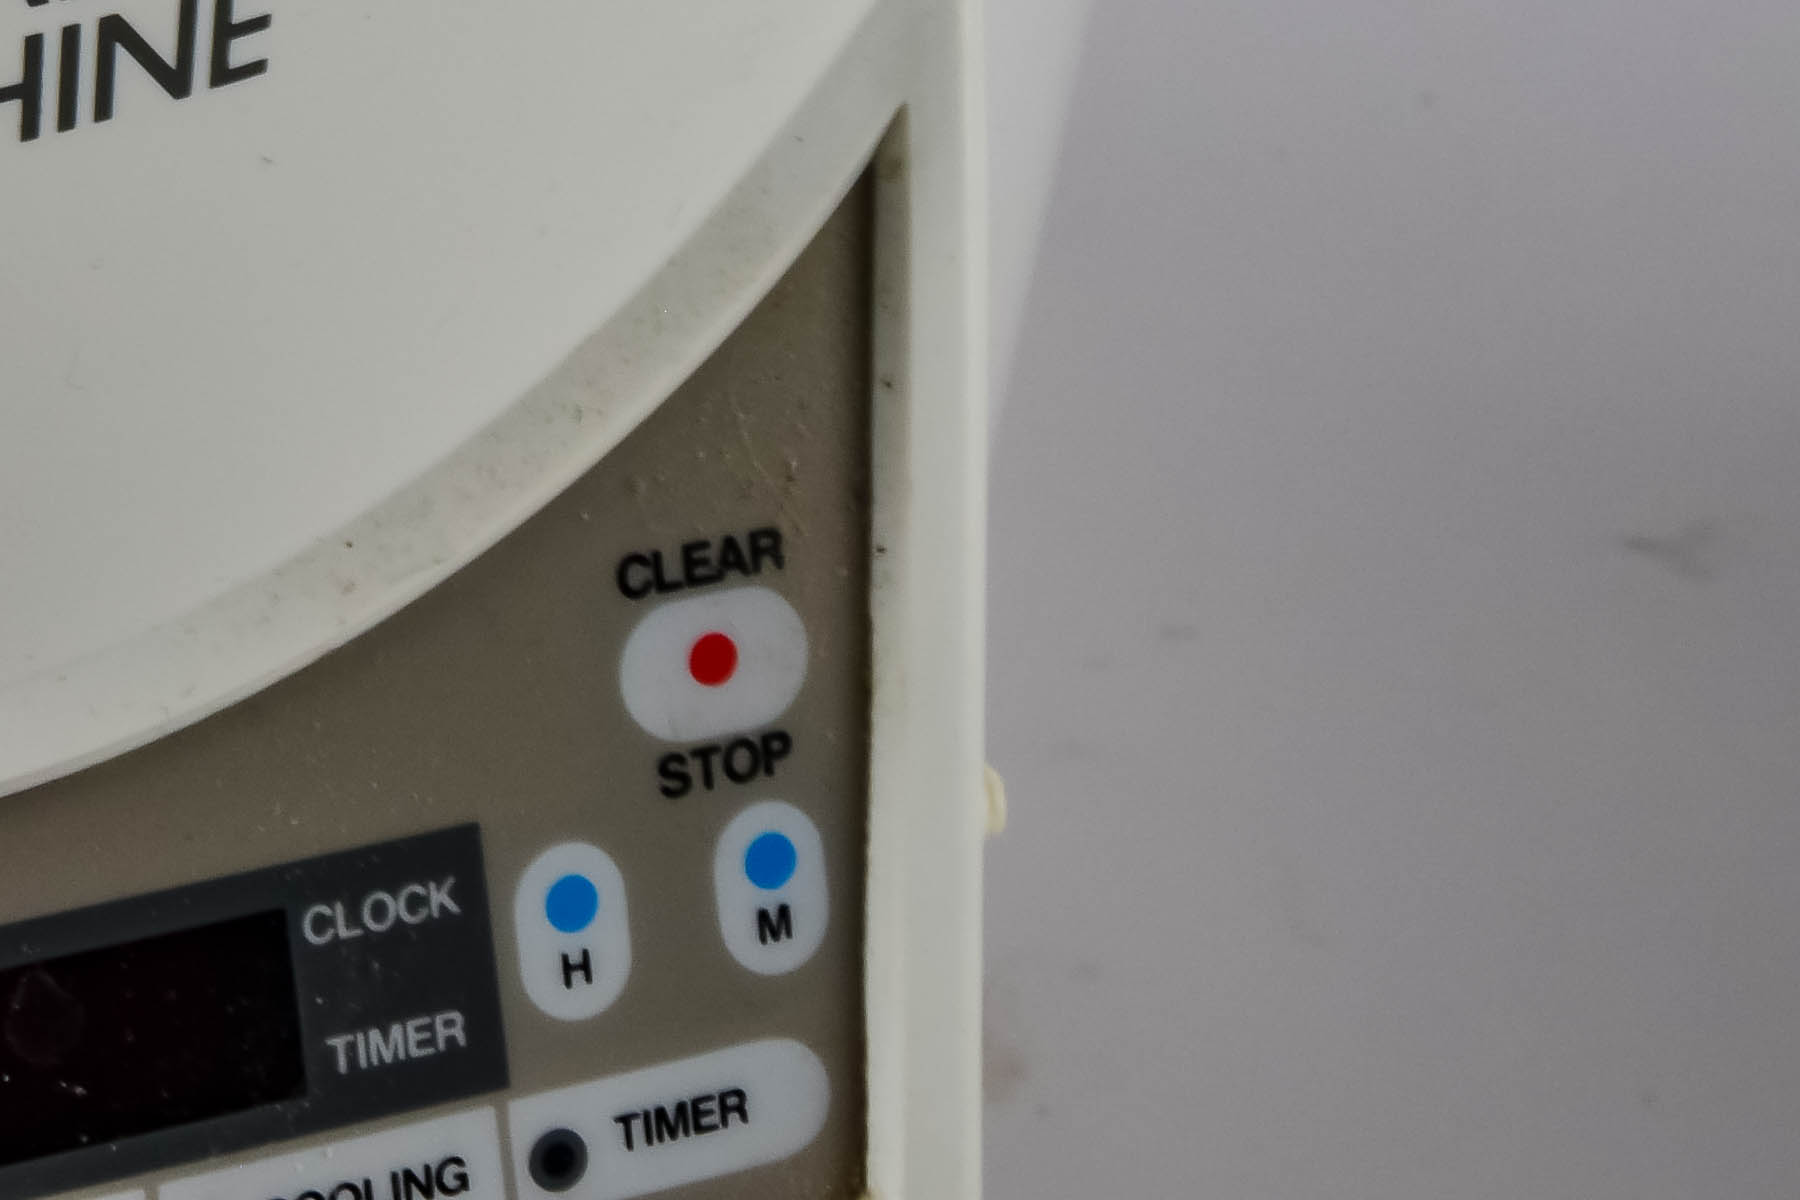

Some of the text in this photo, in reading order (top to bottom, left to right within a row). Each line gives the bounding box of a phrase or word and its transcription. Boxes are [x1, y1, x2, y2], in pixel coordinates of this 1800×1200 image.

[615, 526, 785, 601] CLEAR
[656, 730, 793, 800] STOP
[302, 877, 461, 945] CLOCK
[756, 903, 793, 946] M
[560, 948, 593, 990] H
[325, 1010, 466, 1075] TIMER
[613, 1087, 749, 1151] TIMER
[268, 1155, 470, 1200] LING
